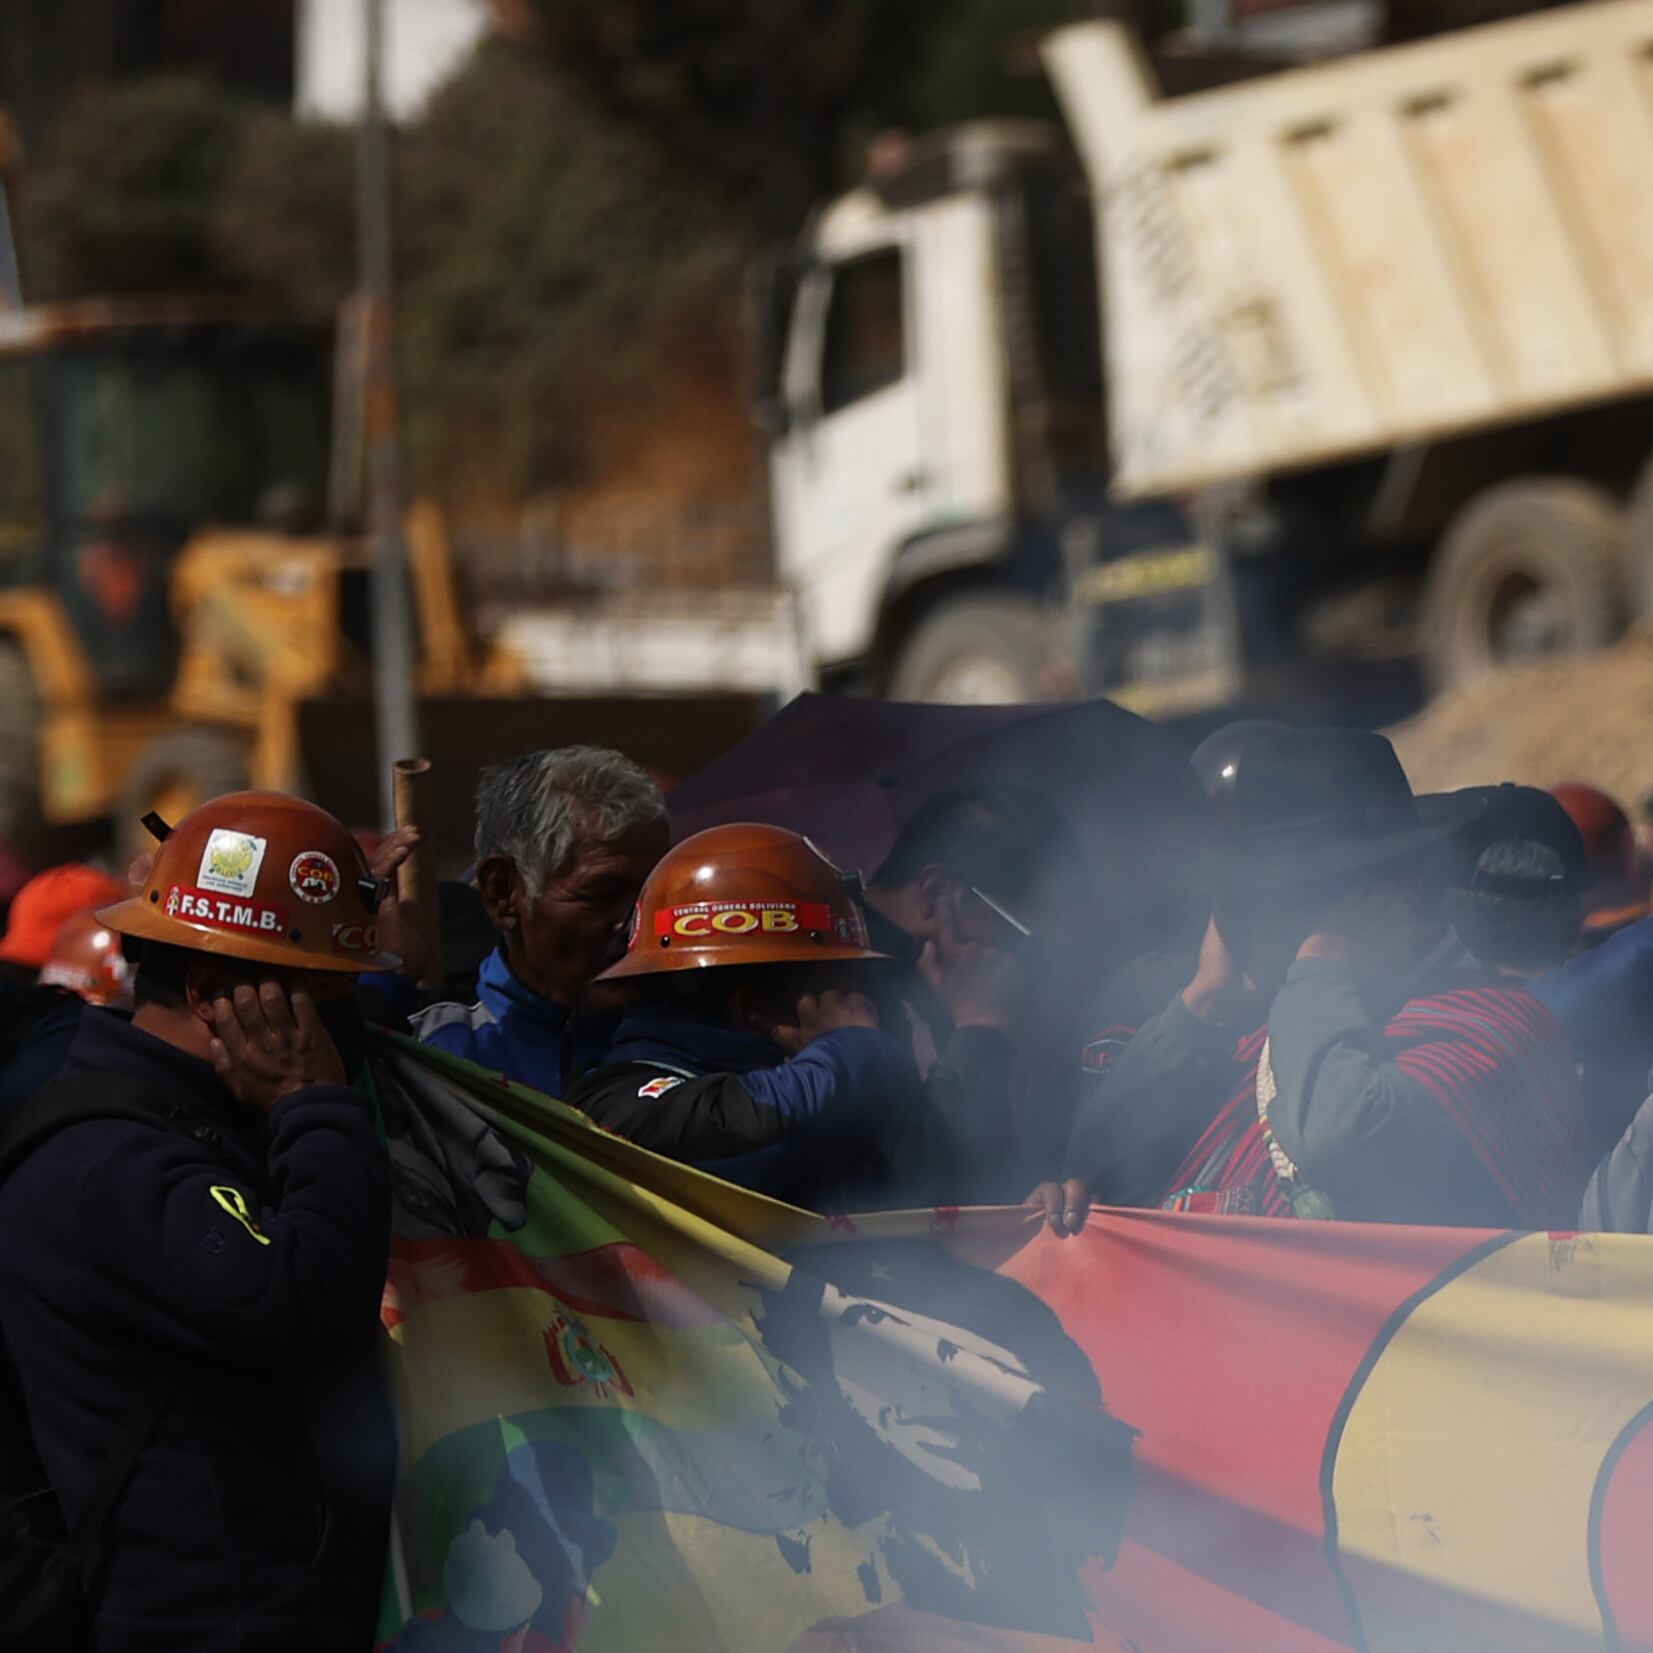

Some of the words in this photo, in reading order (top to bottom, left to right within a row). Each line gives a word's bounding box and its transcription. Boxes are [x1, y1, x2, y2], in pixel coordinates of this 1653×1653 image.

[180, 895, 284, 933] F.S.T.M.B.
[674, 905, 709, 916] CENTRAL
[711, 903, 748, 912] OBRERA
[749, 902, 797, 912] BOLIVIANA
[673, 910, 800, 937] COB
